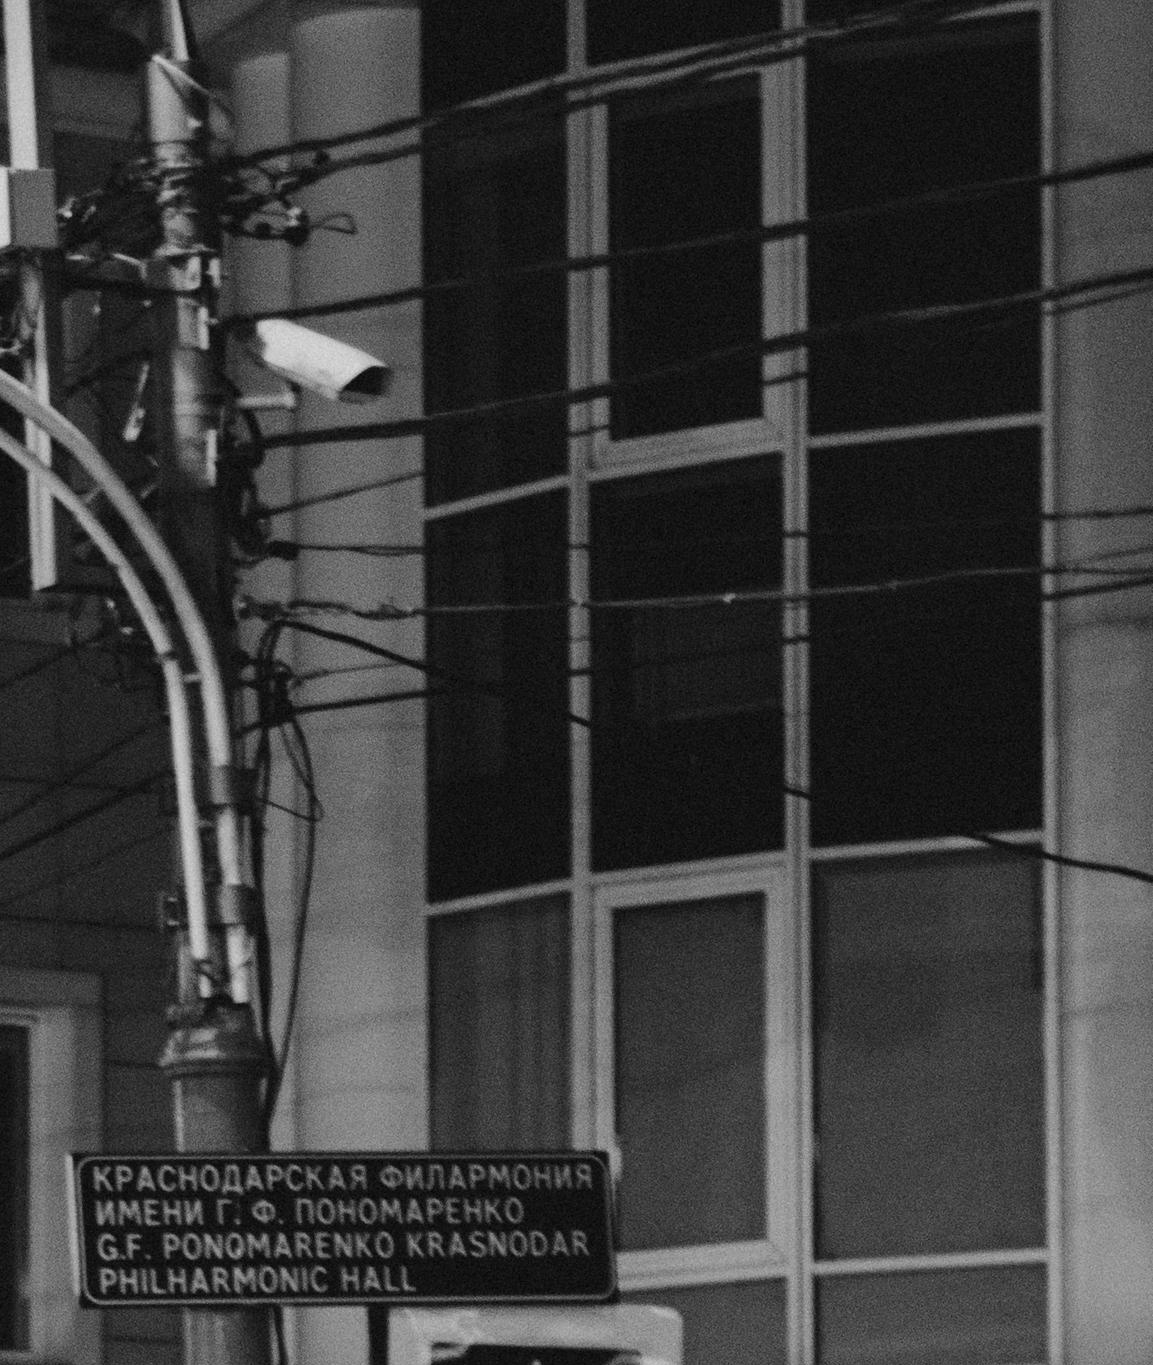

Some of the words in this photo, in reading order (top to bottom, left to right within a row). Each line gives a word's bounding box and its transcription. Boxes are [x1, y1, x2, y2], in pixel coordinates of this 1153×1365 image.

[92, 1164, 368, 1196] КРАСНОДАРСКАЯ
[379, 1163, 592, 1191] ФИЛАРМОНИЯ
[96, 1199, 203, 1226] ИМЕНИ
[251, 1200, 284, 1225] Ф.
[295, 1197, 524, 1225] ПОНОМАРЕНКО
[162, 1231, 395, 1260] PONOMARENKO
[405, 1230, 590, 1258] KRASNODAR
[99, 1265, 328, 1294] PHILHARMONIC
[340, 1265, 416, 1292] HALL
